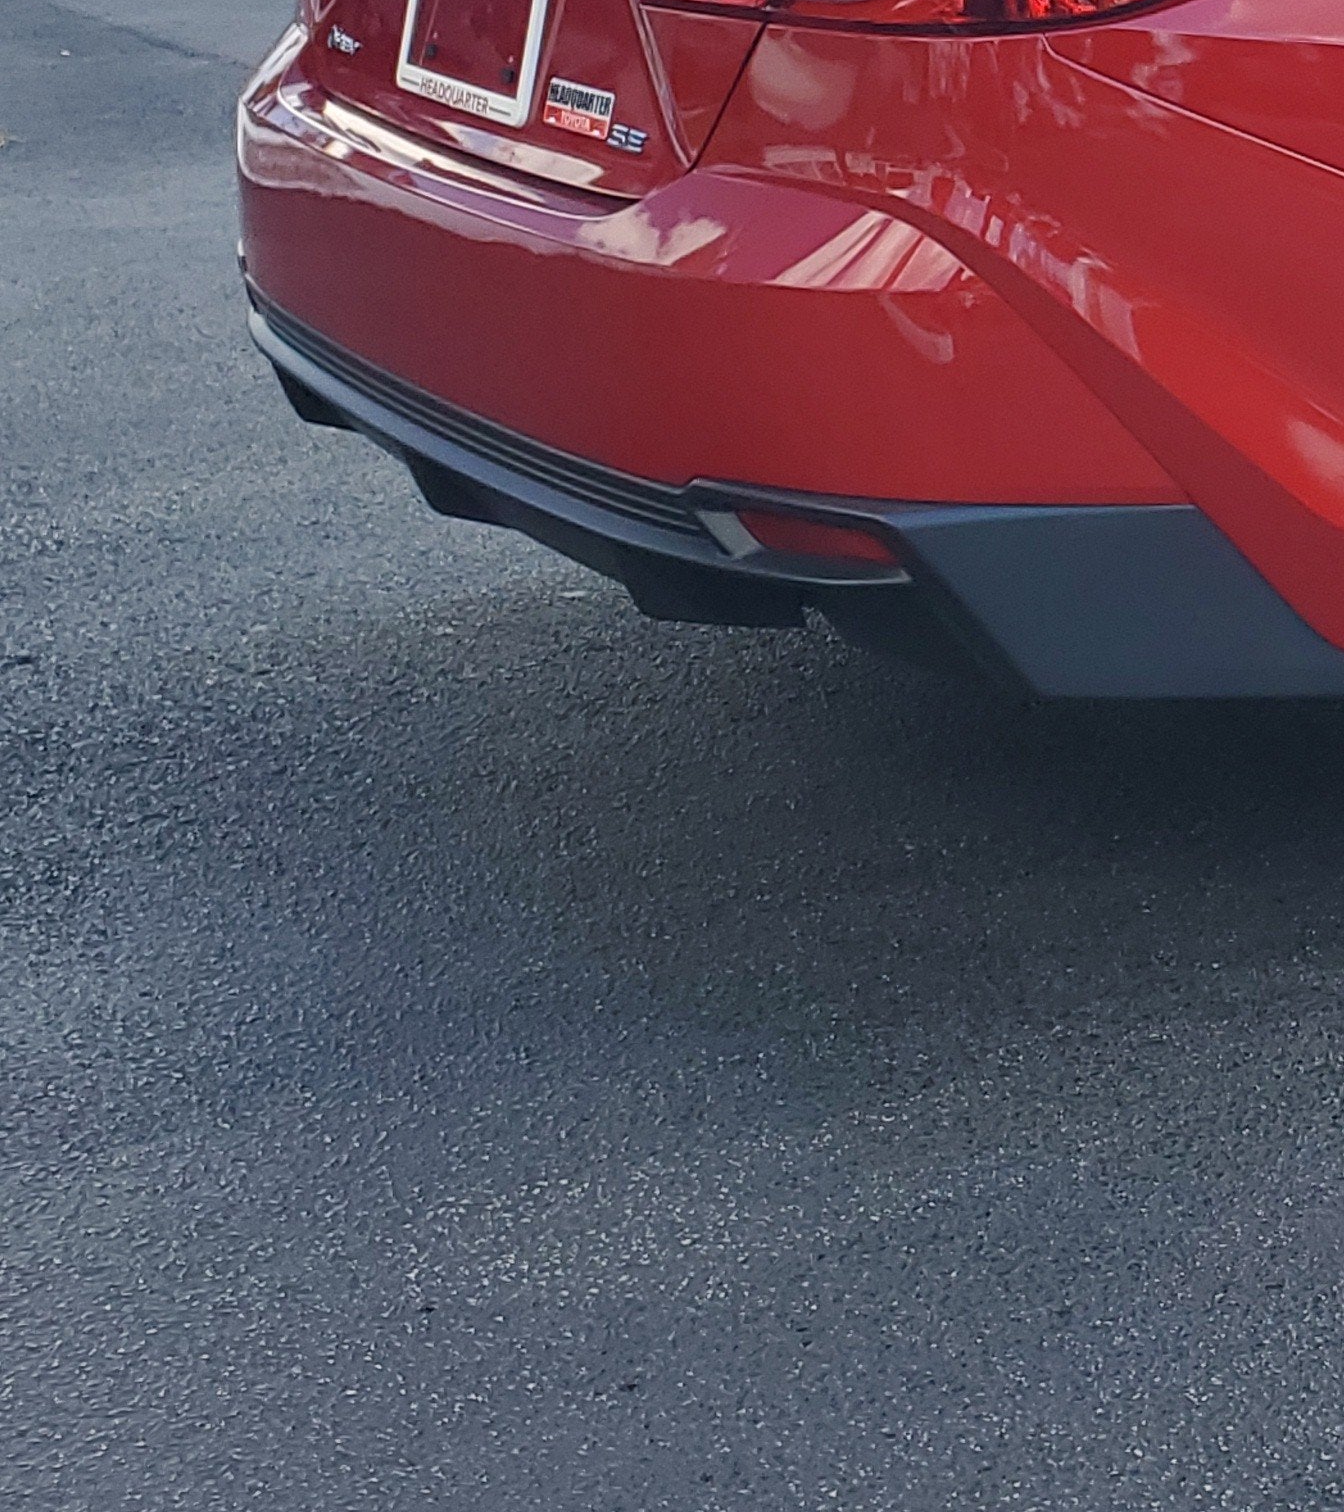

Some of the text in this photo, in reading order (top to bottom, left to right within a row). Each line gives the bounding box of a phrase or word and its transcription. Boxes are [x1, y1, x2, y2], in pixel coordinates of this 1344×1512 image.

[420, 76, 490, 116] HEADQUARTER
[549, 82, 612, 118] HEADQUARTER
[606, 123, 648, 153] SE
